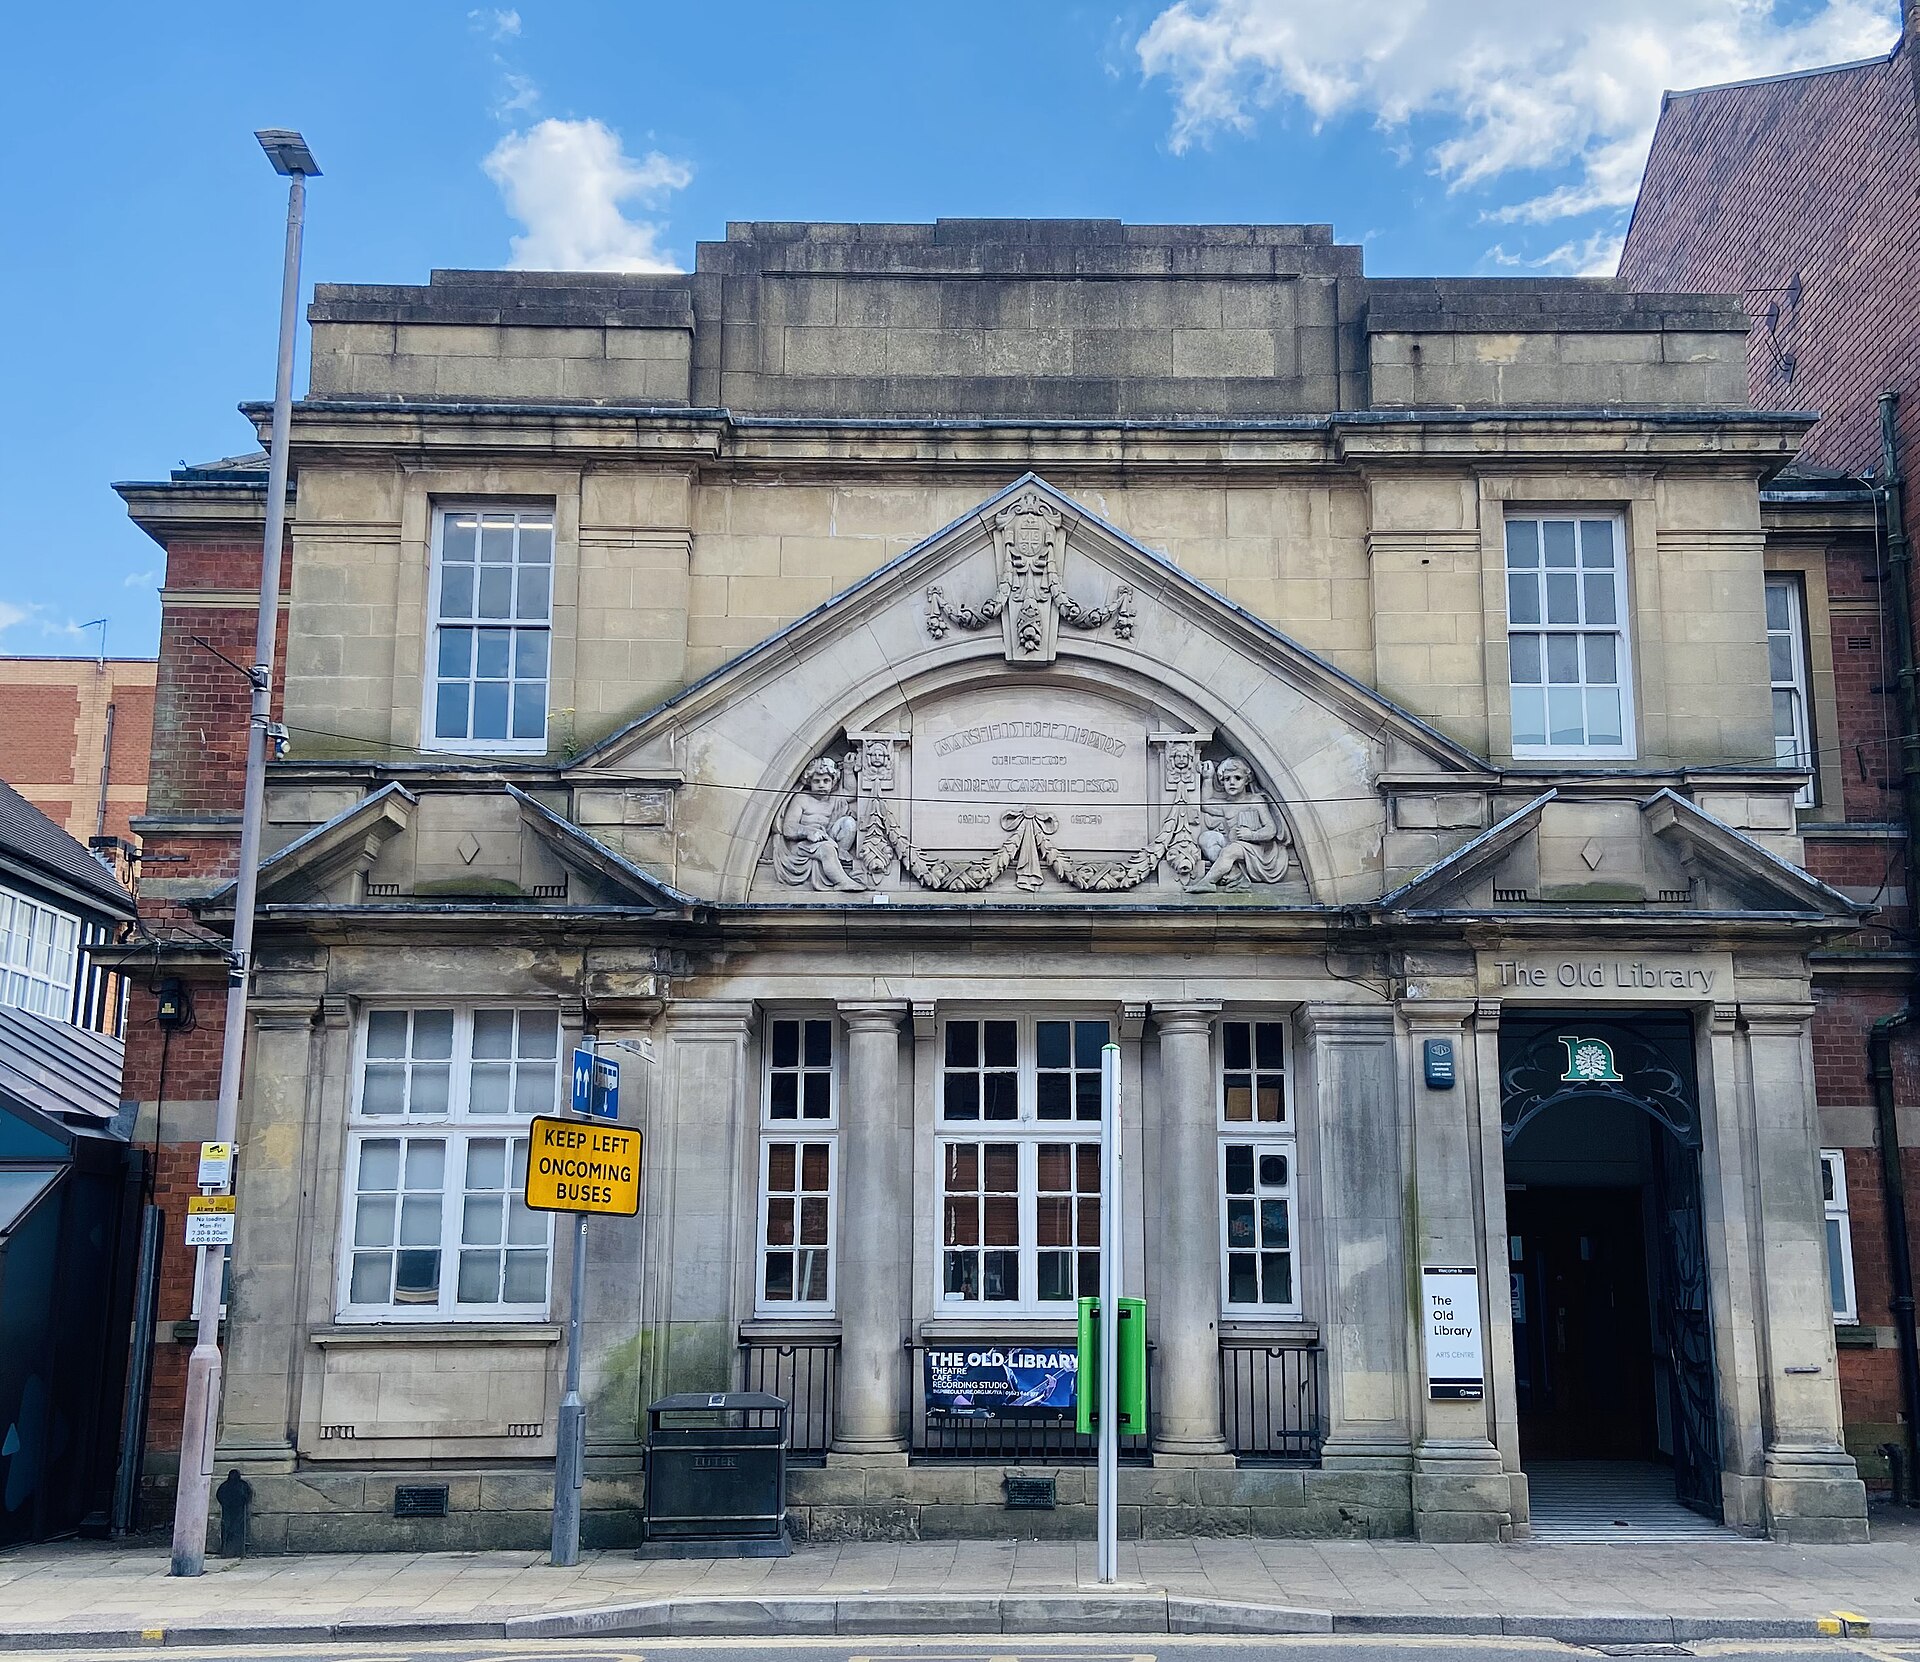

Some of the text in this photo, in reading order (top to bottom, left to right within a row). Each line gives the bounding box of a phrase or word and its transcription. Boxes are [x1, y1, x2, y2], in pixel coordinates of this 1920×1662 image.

[939, 778, 1001, 792] ANDREW
[1006, 778, 1077, 792] CARNEGIE
[1494, 961, 1716, 994] The Old Library
[544, 1128, 630, 1154] KEEP LEFT
[539, 1157, 631, 1183] ONCOMING
[556, 1183, 612, 1203] BUSES
[1431, 1295, 1452, 1305] The
[1433, 1310, 1454, 1320] Old
[1434, 1325, 1473, 1337] Library
[929, 1352, 1079, 1368] THE OLD LIBRARY
[931, 1367, 967, 1375] THEATRE
[932, 1374, 952, 1382] CAFE
[932, 1381, 978, 1389] RECORDING
[694, 1456, 735, 1466] LITTER
